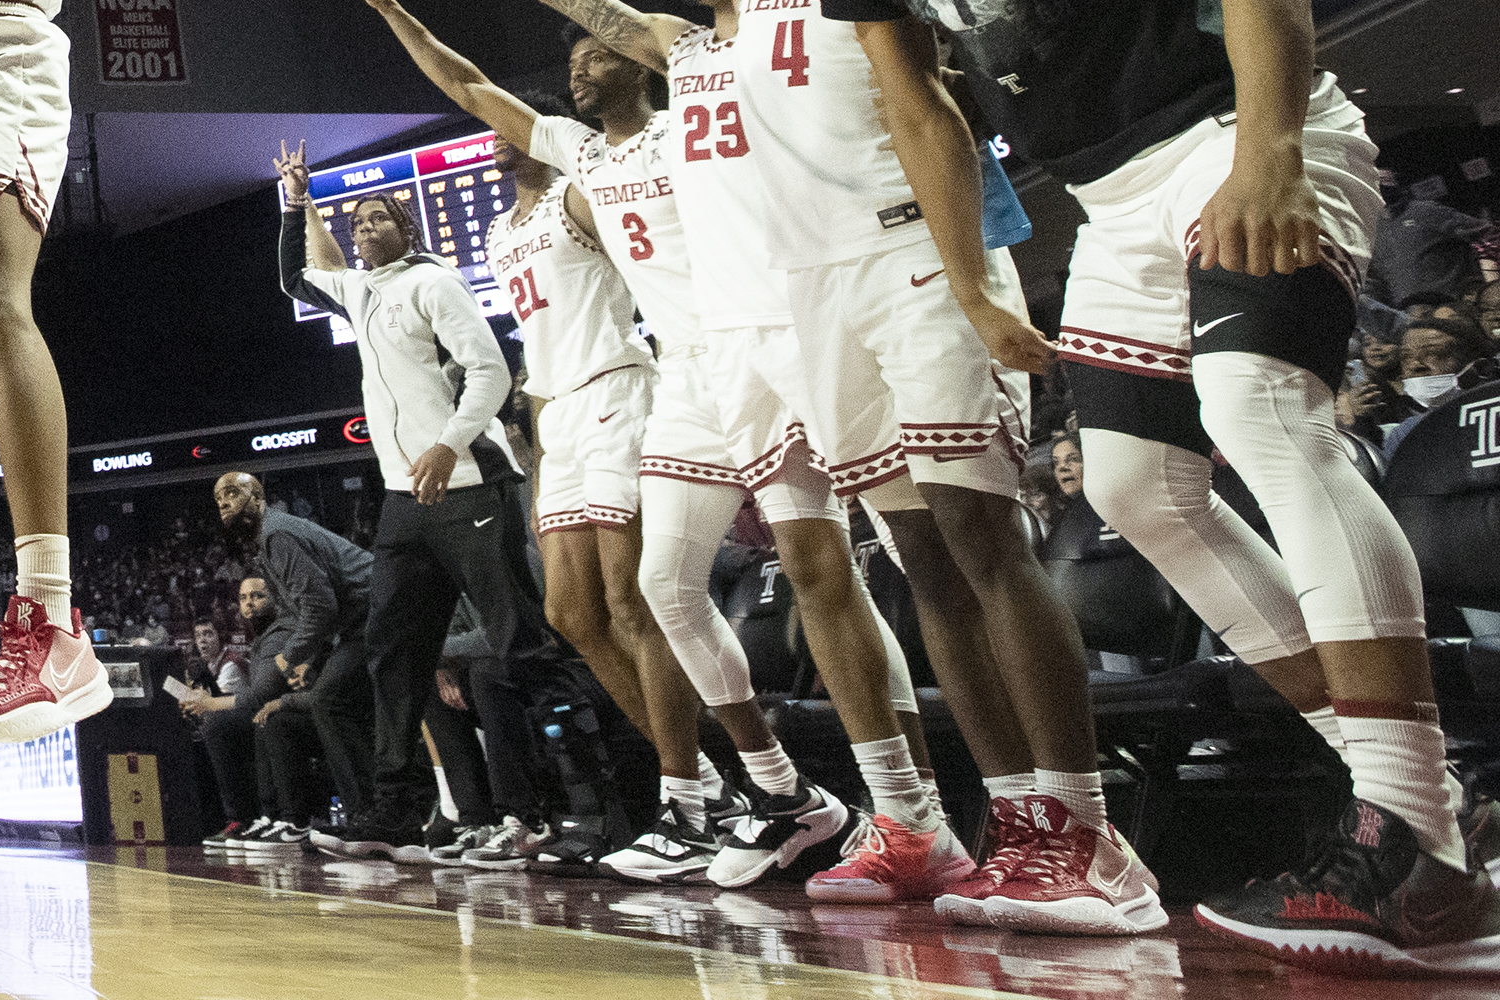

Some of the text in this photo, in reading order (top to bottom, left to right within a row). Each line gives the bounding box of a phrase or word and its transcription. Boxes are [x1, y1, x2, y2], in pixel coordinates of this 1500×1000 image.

[110, 25, 170, 36] BASKETBALL
[112, 37, 139, 49] ELITE
[108, 51, 177, 78] 2001
[771, 19, 810, 87] 4
[683, 101, 750, 163] 23
[342, 167, 385, 187] TULSA
[460, 190, 475, 203] 11
[592, 176, 673, 206] TEMPLE
[622, 212, 654, 261] 3
[497, 232, 553, 276] TEMPLE
[509, 267, 549, 322] 21
[251, 428, 318, 451] CROSSFIT
[93, 452, 152, 472] BOWLING
